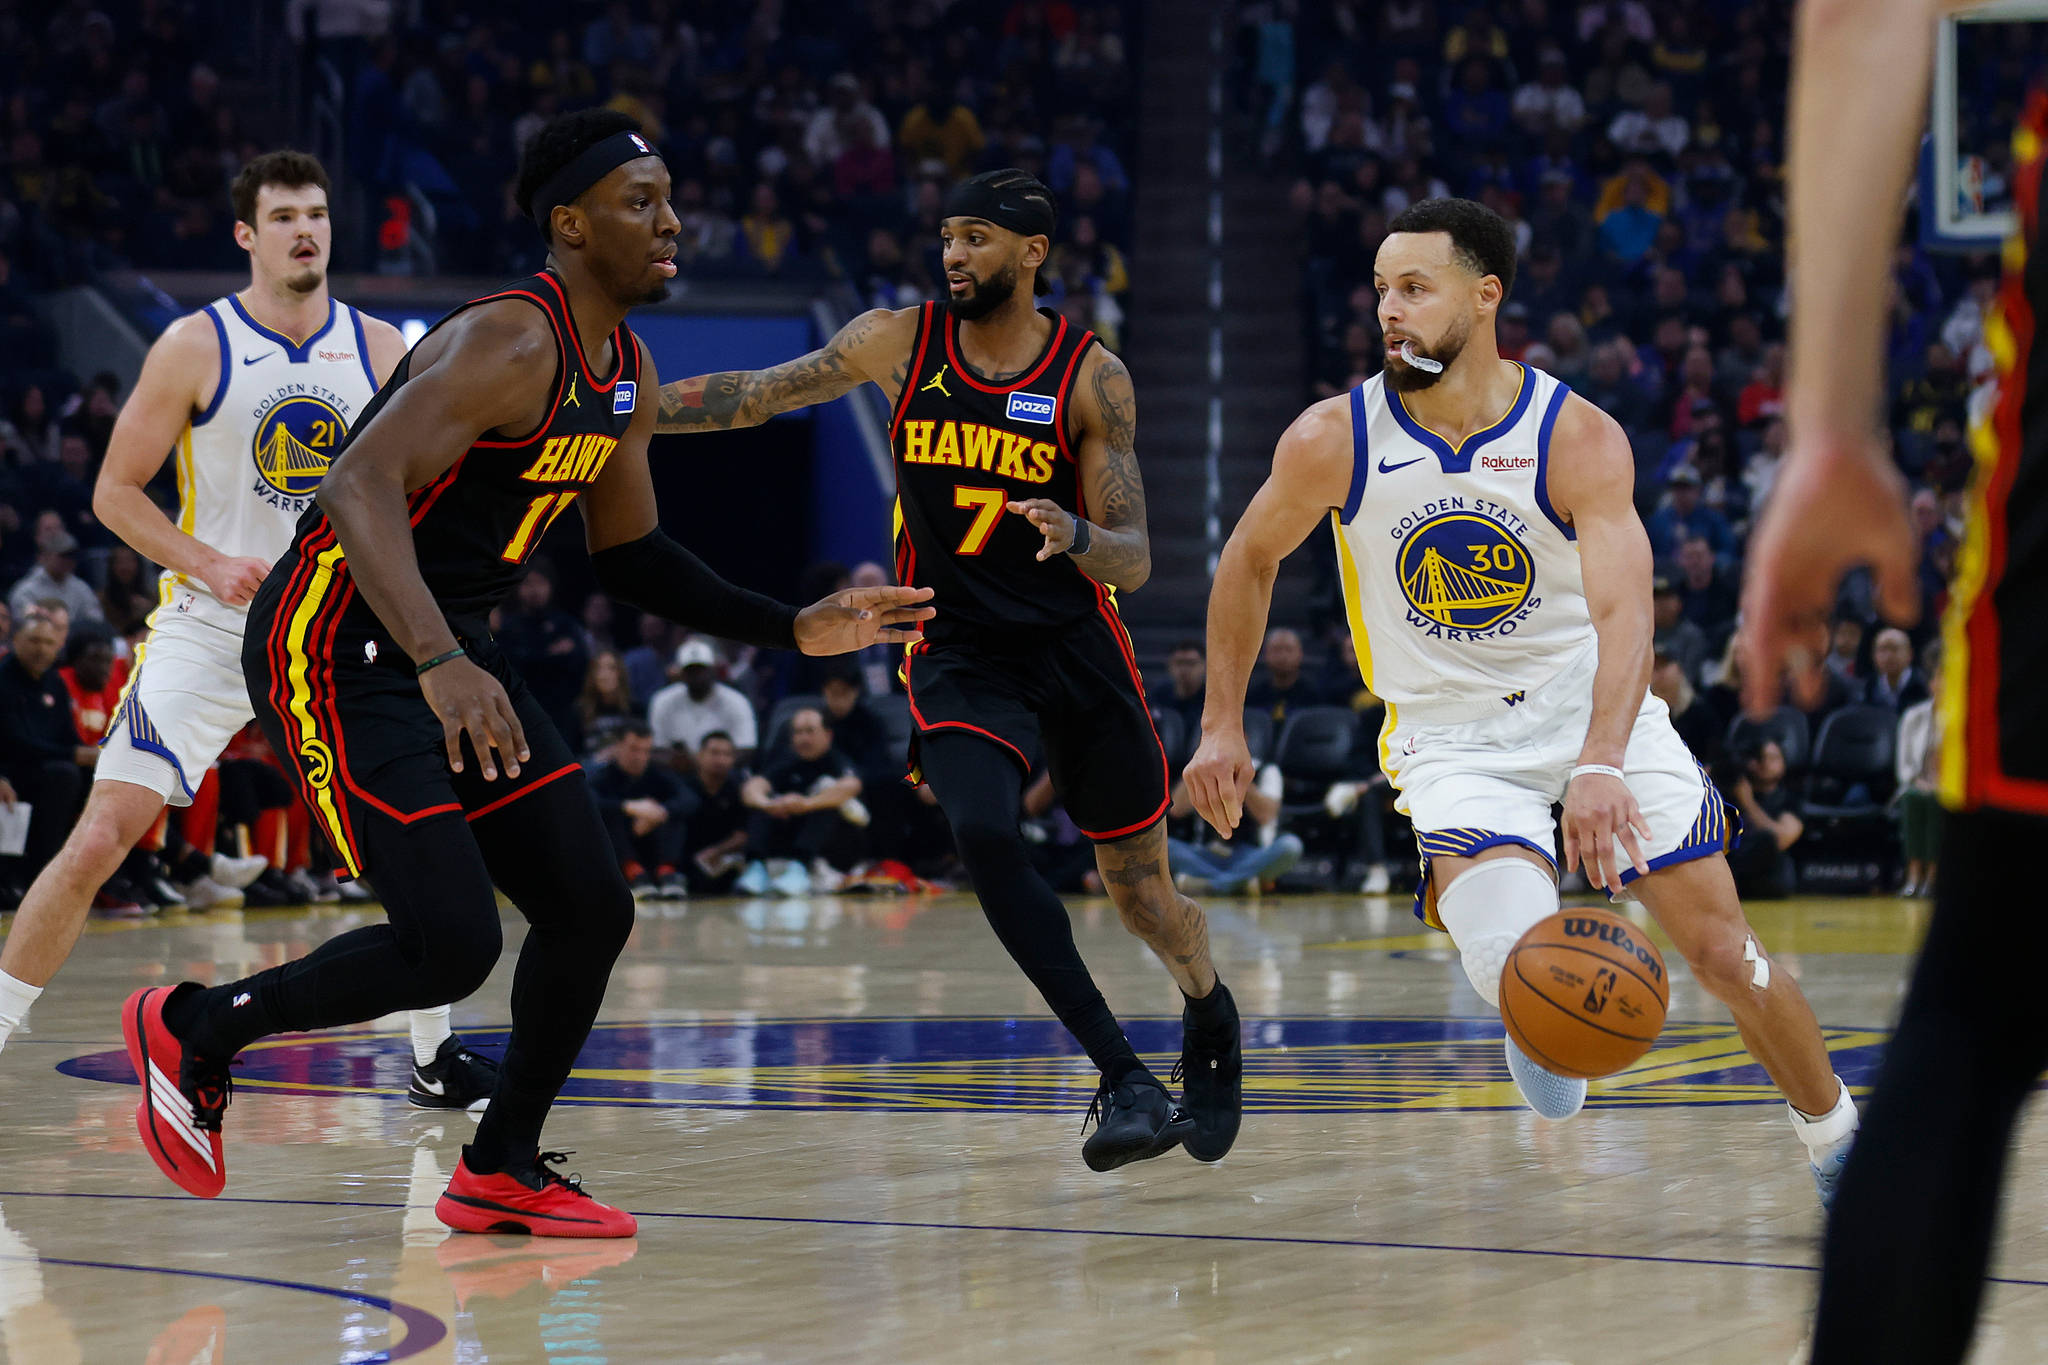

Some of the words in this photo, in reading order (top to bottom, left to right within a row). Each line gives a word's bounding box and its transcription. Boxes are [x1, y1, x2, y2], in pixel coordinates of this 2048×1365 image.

[319, 350, 355, 362] Rakuten
[253, 384, 305, 419] GOLDEN
[313, 386, 351, 415] STATE
[615, 390, 633, 403] aze
[1011, 399, 1051, 415] paze
[310, 421, 336, 447] 21
[903, 419, 1059, 484] HAWKS
[1481, 455, 1535, 472] Rakuten
[954, 485, 1008, 556] 7
[1391, 496, 1464, 539] GOLDEN
[1474, 499, 1528, 537] STATE
[1467, 543, 1516, 572] 30
